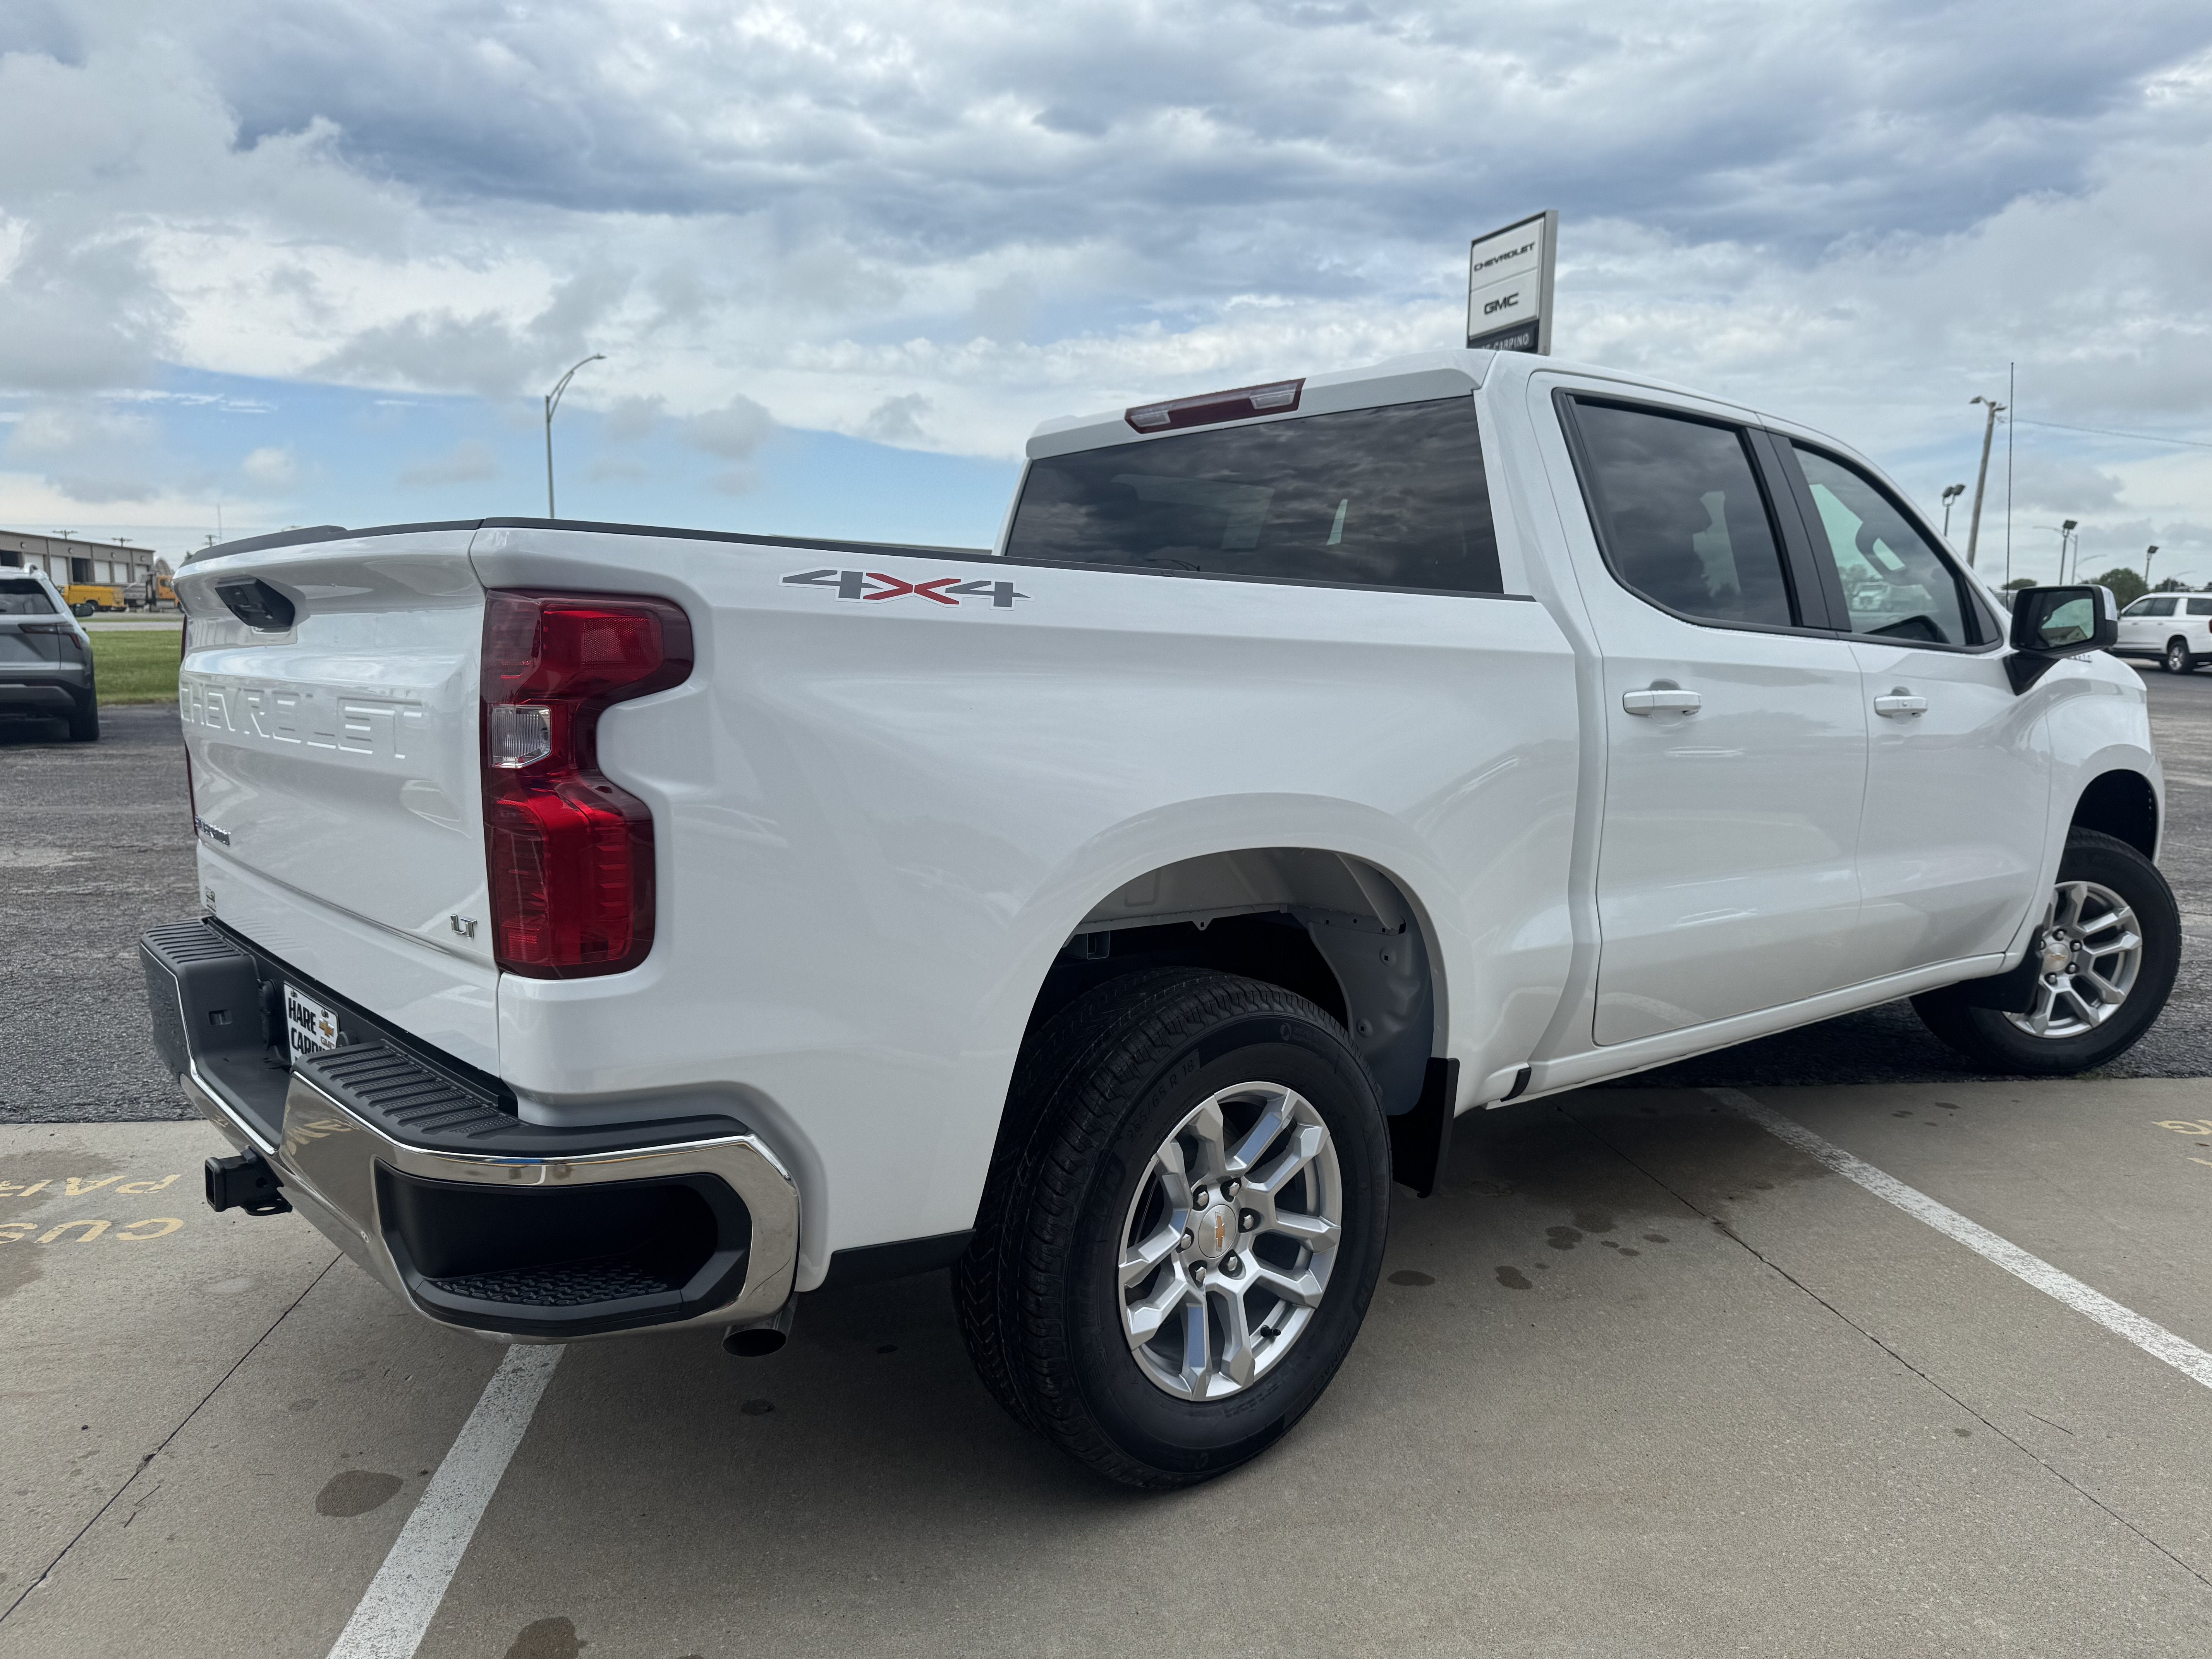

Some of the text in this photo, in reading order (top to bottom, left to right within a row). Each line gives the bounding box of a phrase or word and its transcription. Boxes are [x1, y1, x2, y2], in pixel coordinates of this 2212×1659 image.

[1474, 242, 1535, 272] CHEVROLET
[1484, 292, 1519, 315] GMC
[181, 680, 423, 759] CHEVROLET
[450, 914, 477, 939] LT
[288, 997, 317, 1036] HARE
[1127, 1059, 1194, 1142] 265/65 R 18
